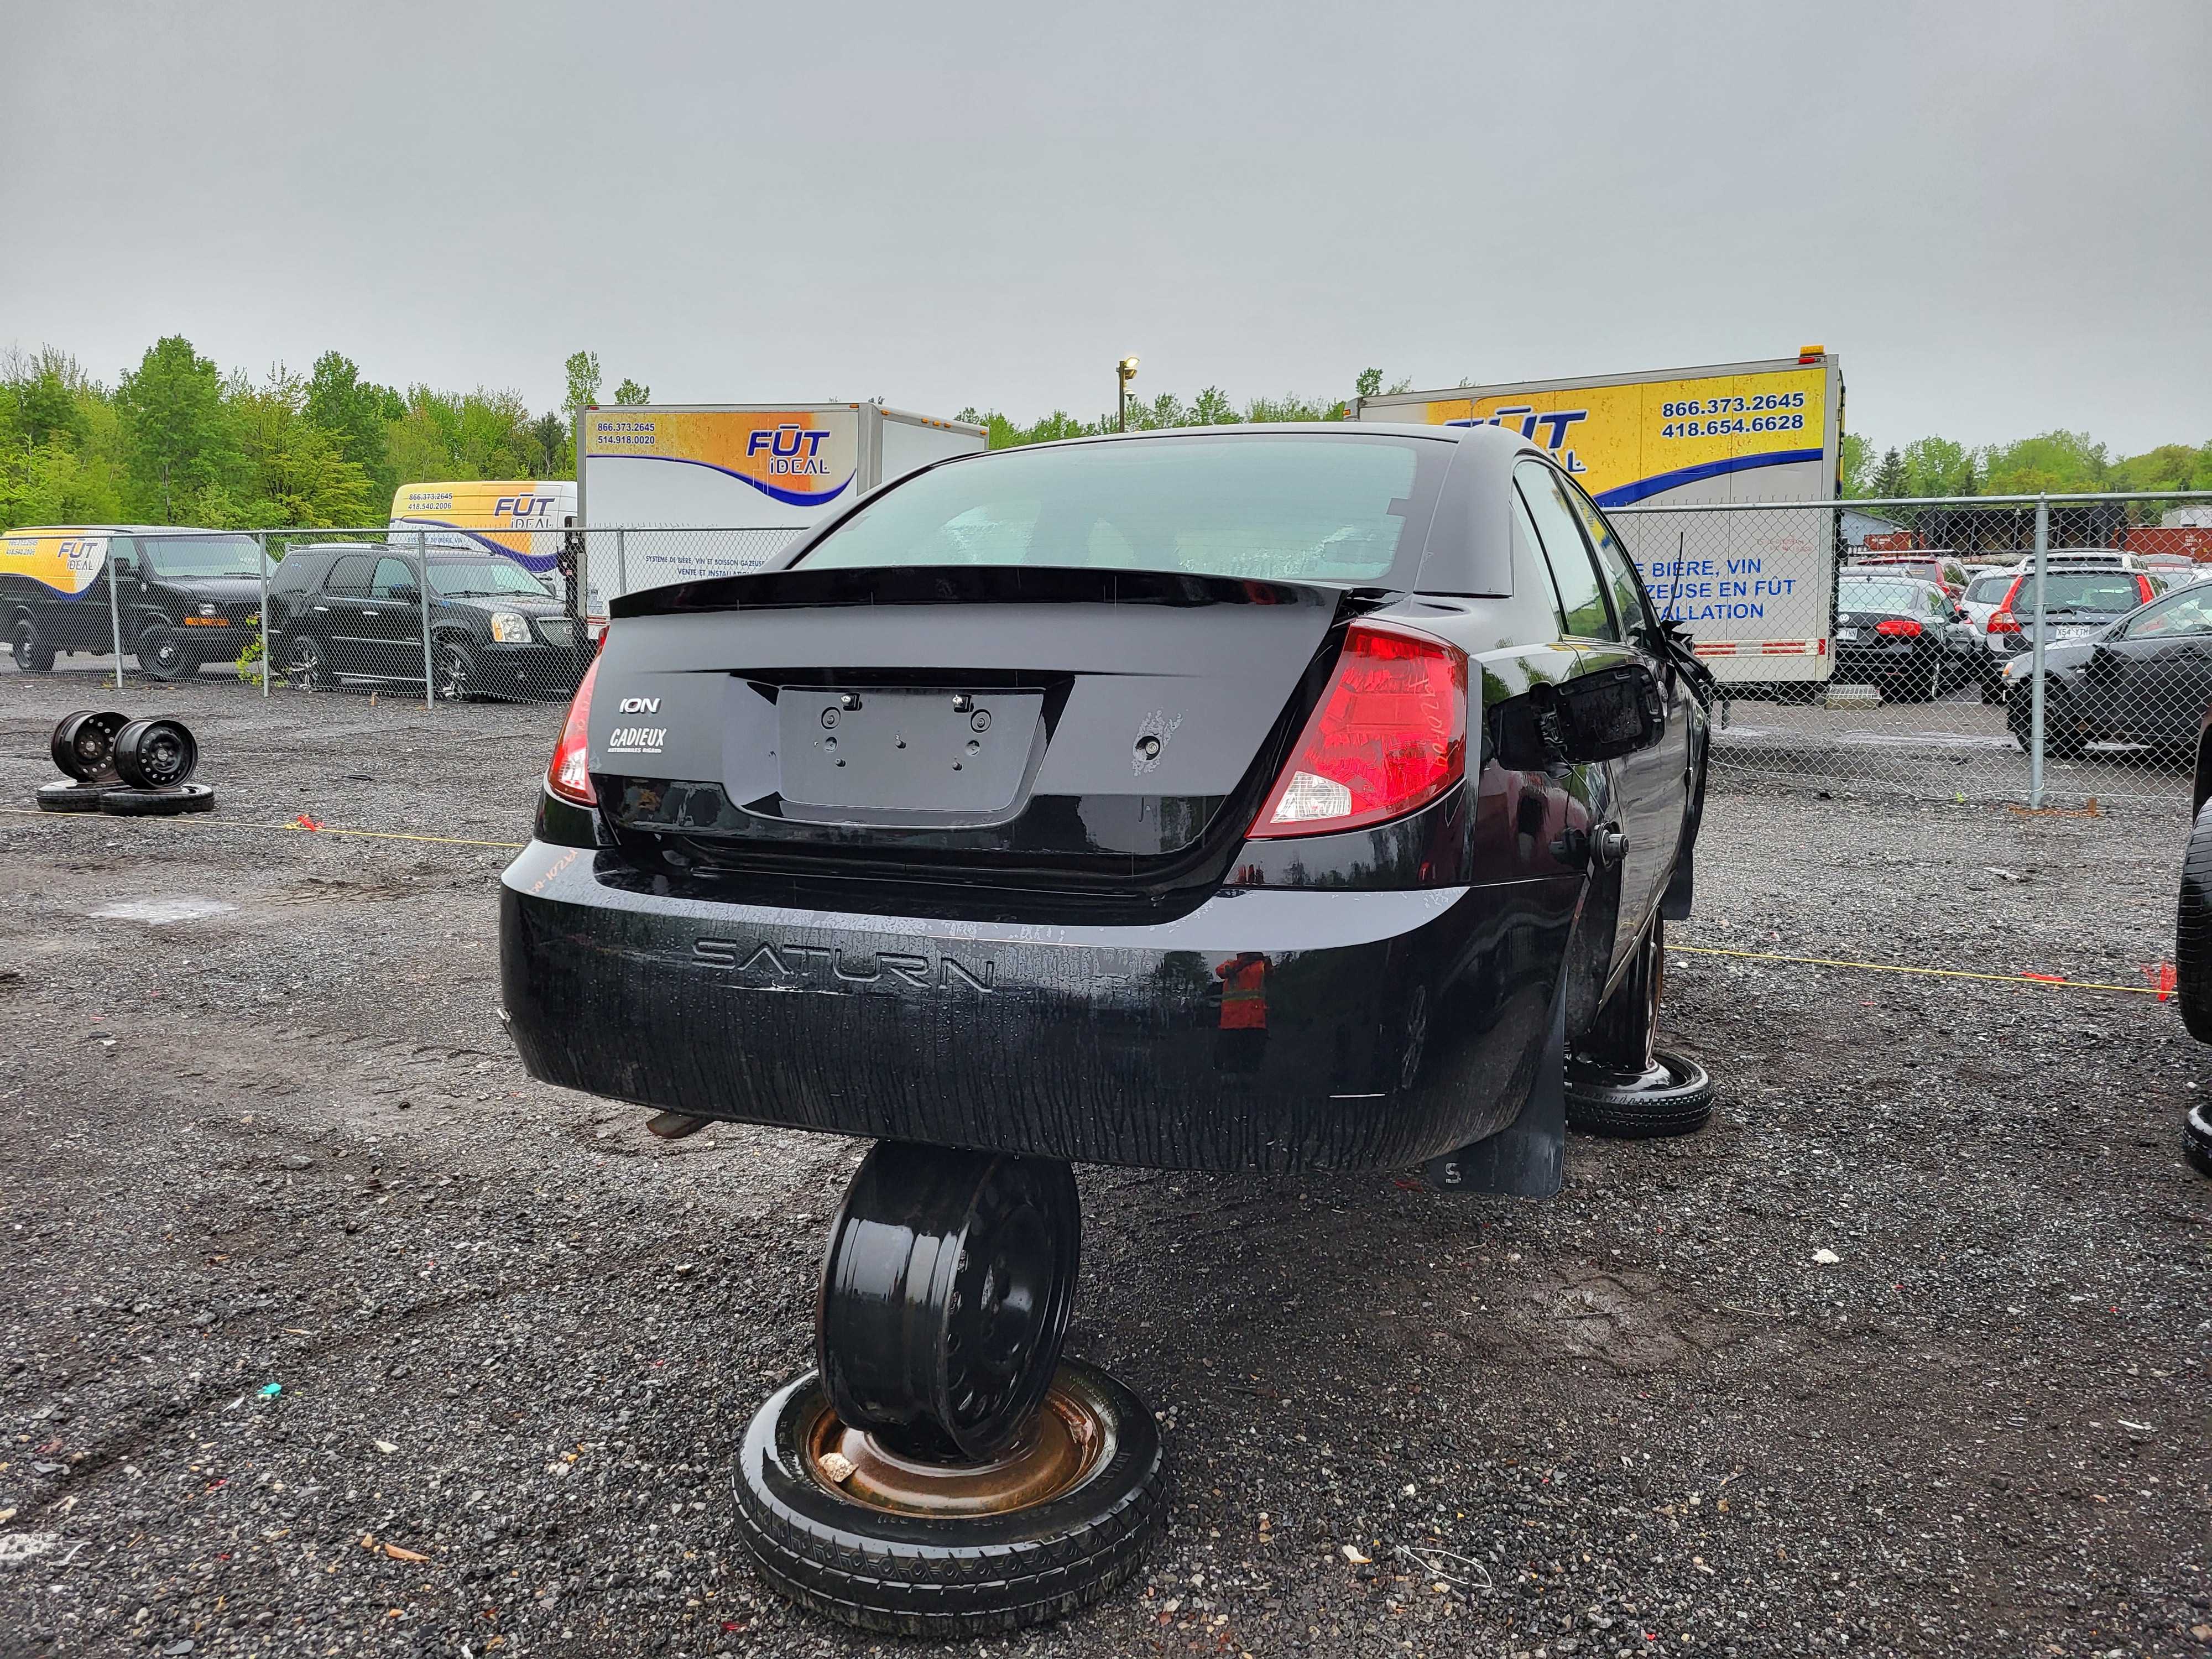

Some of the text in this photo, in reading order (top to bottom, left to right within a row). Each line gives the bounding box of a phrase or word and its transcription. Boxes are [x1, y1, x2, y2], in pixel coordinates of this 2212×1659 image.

[1662, 393, 1804, 417] 866.373.2645
[598, 423, 655, 431] 866.373.2645
[1662, 415, 1804, 438] 418.654.6628
[598, 436, 655, 444] 514.918.0020
[1727, 559, 1761, 575] VIN
[1645, 576, 1796, 600] ZEUSE EN FÛT
[619, 697, 661, 714] ION
[609, 727, 667, 747] CADIEUX
[692, 937, 994, 994] SATURN
